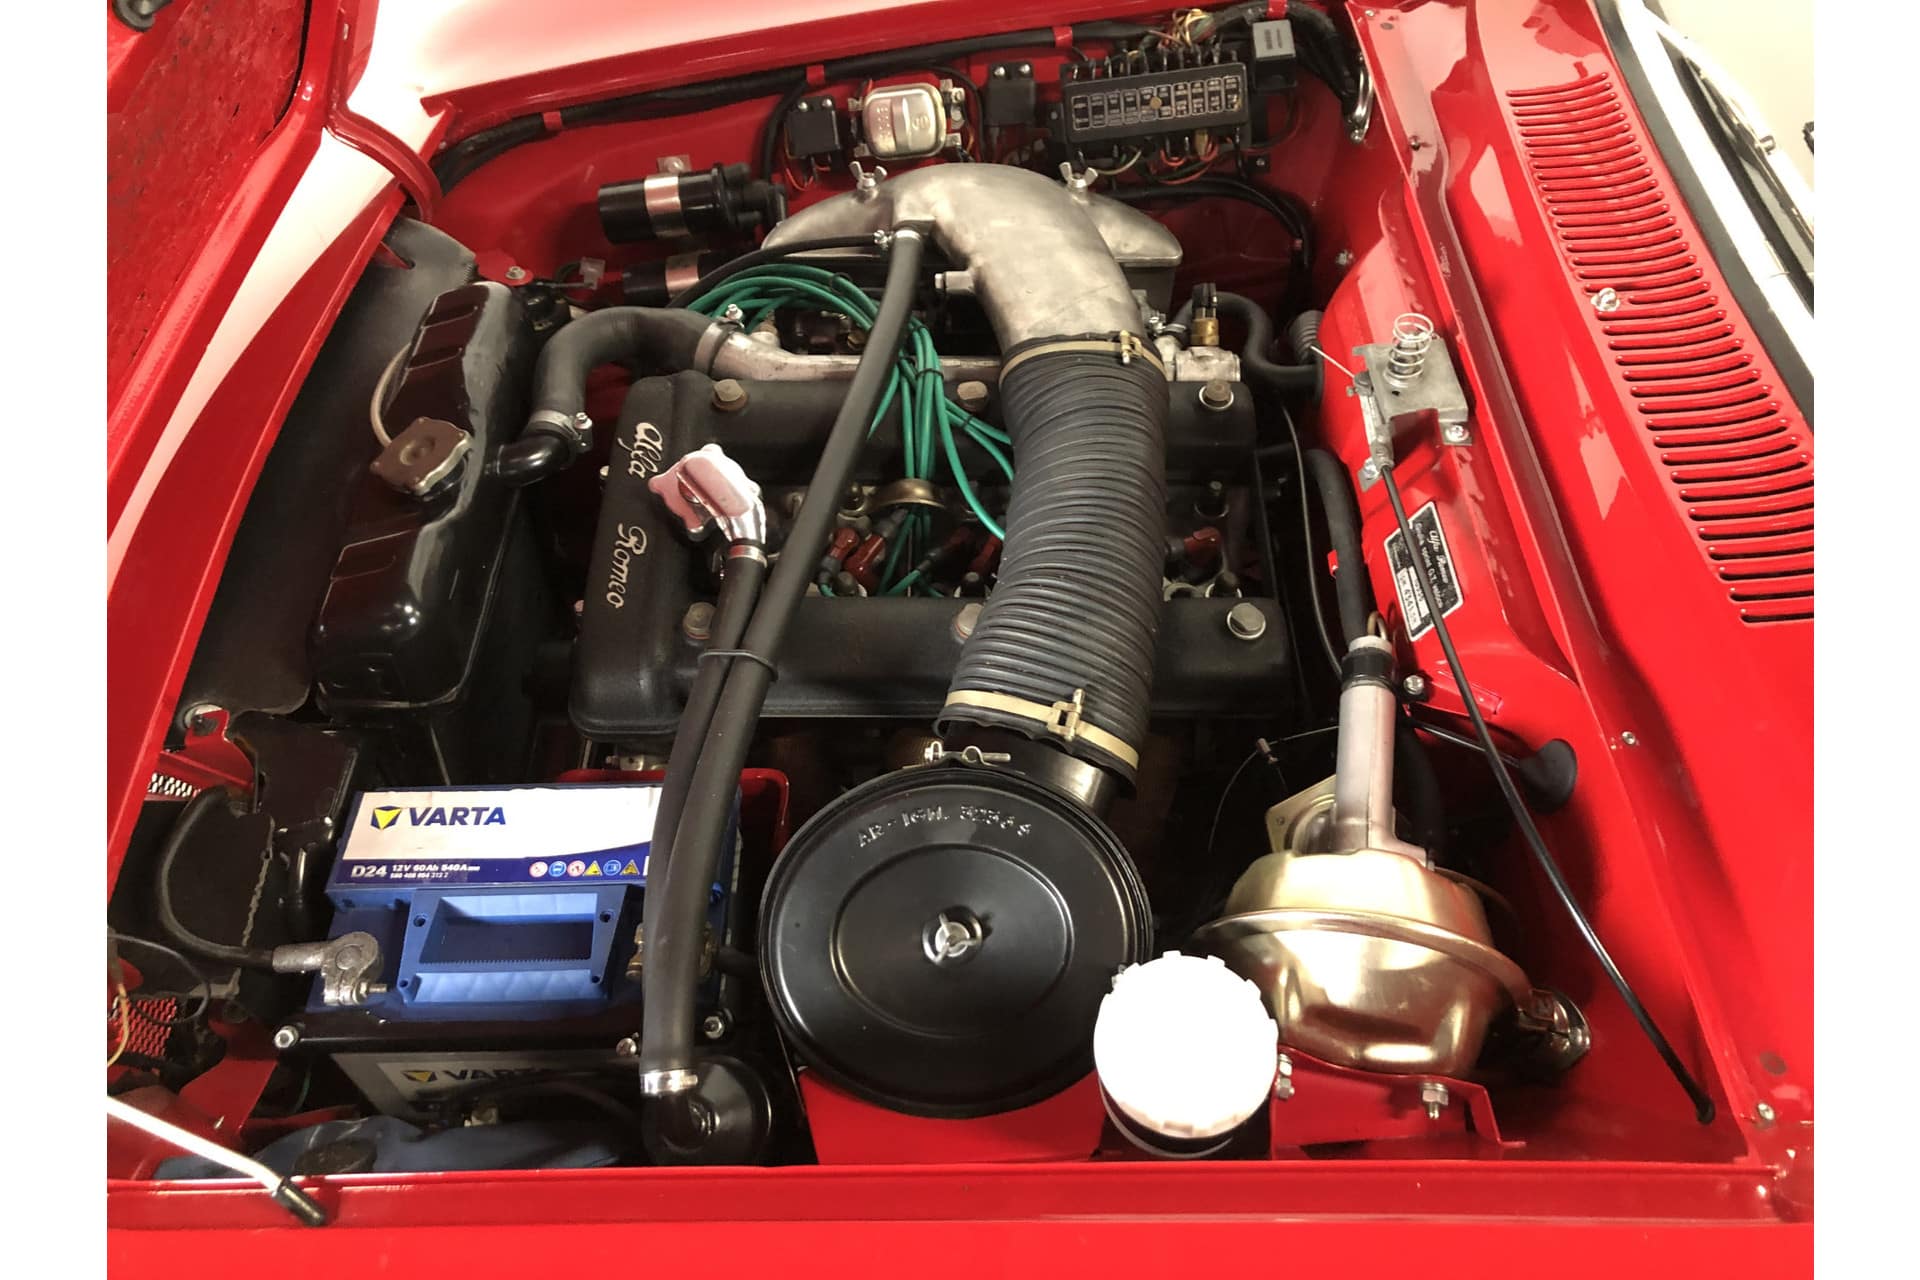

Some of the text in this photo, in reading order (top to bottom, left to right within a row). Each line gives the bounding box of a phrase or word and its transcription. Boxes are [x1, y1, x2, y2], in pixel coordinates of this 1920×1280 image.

[606, 422, 663, 609] Alfa Romeo
[1426, 530, 1441, 553] Alfa
[409, 806, 507, 826] VARTA
[351, 864, 388, 878] D24
[392, 864, 412, 872] 12V
[413, 863, 440, 872] 60Ah
